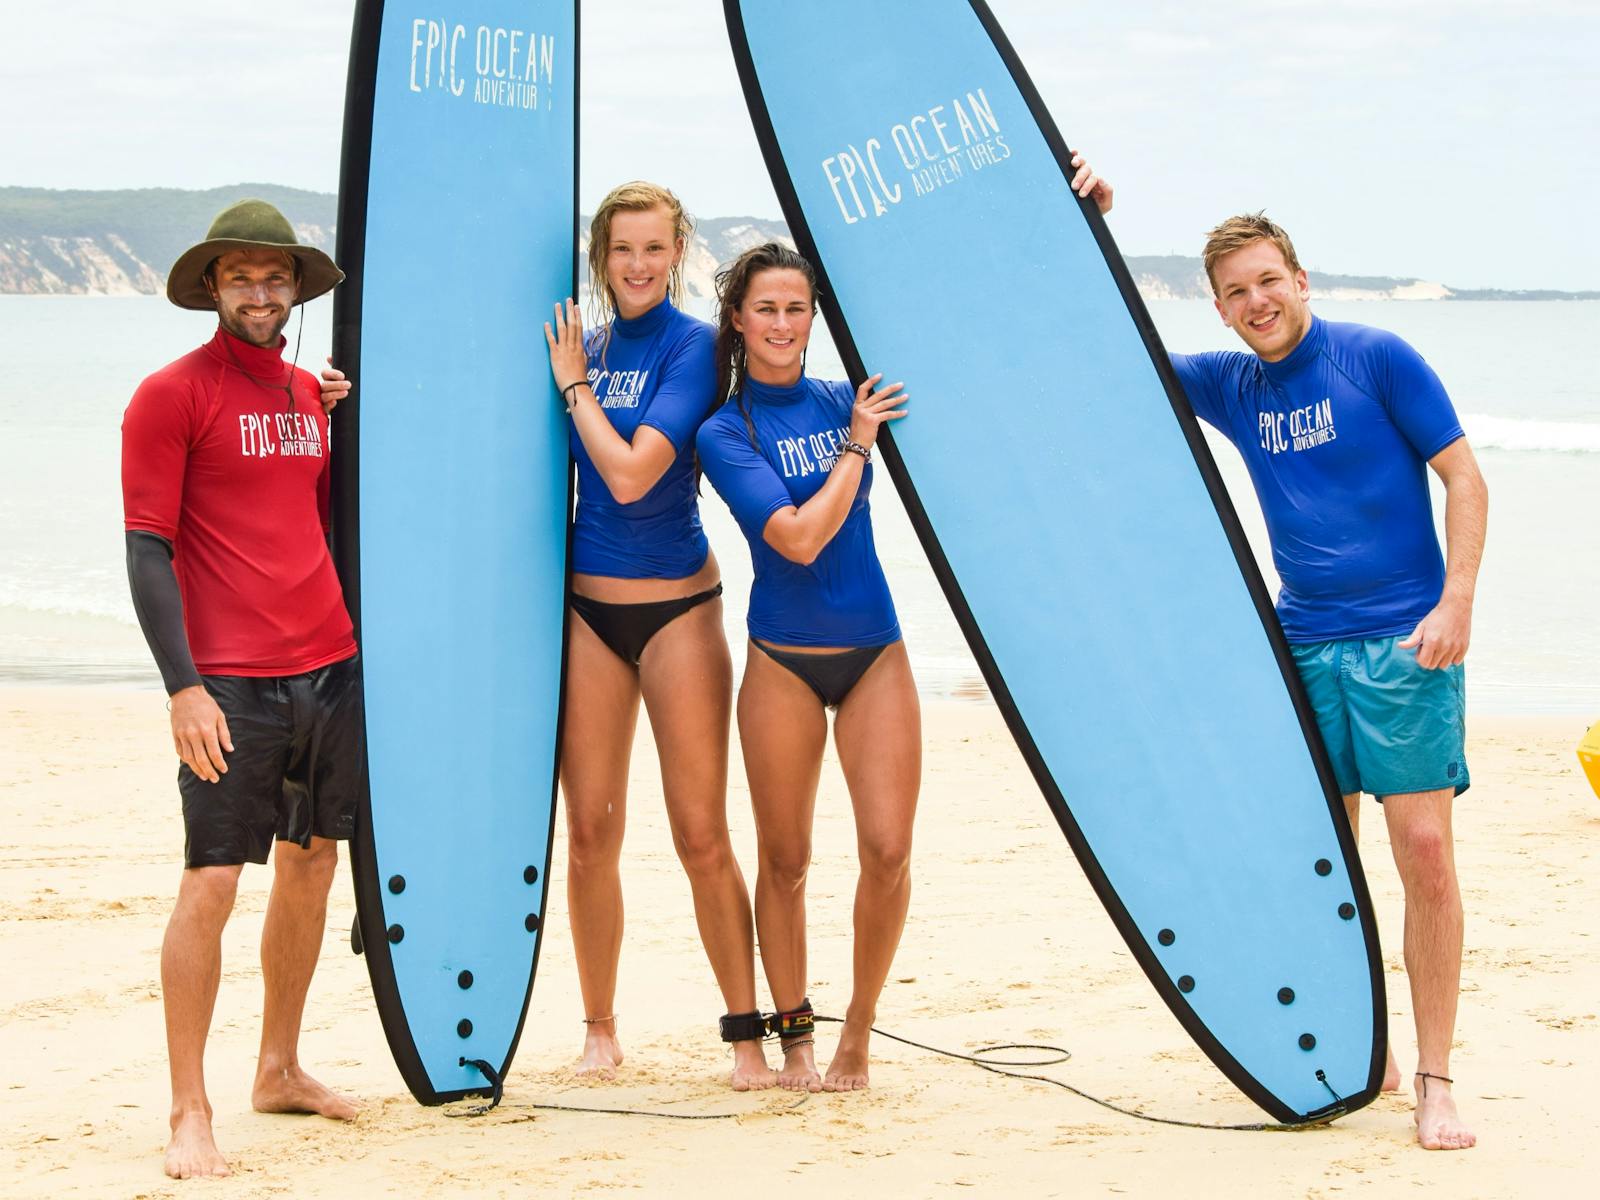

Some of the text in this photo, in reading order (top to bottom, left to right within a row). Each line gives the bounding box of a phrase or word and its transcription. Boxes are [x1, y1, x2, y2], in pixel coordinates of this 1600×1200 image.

[410, 17, 555, 97] EPIC OCEAN
[474, 77, 552, 112] ADVENTUR
[821, 88, 1001, 225] EPIC OCEAN
[606, 369, 649, 396] OCEAN
[239, 411, 321, 458] EPIC OCEAN
[1258, 397, 1333, 455] EPIC OCEAN
[1293, 425, 1337, 453] ADVENTURES
[280, 440, 323, 458] ADVENTURES
[776, 436, 815, 478] EPIC
